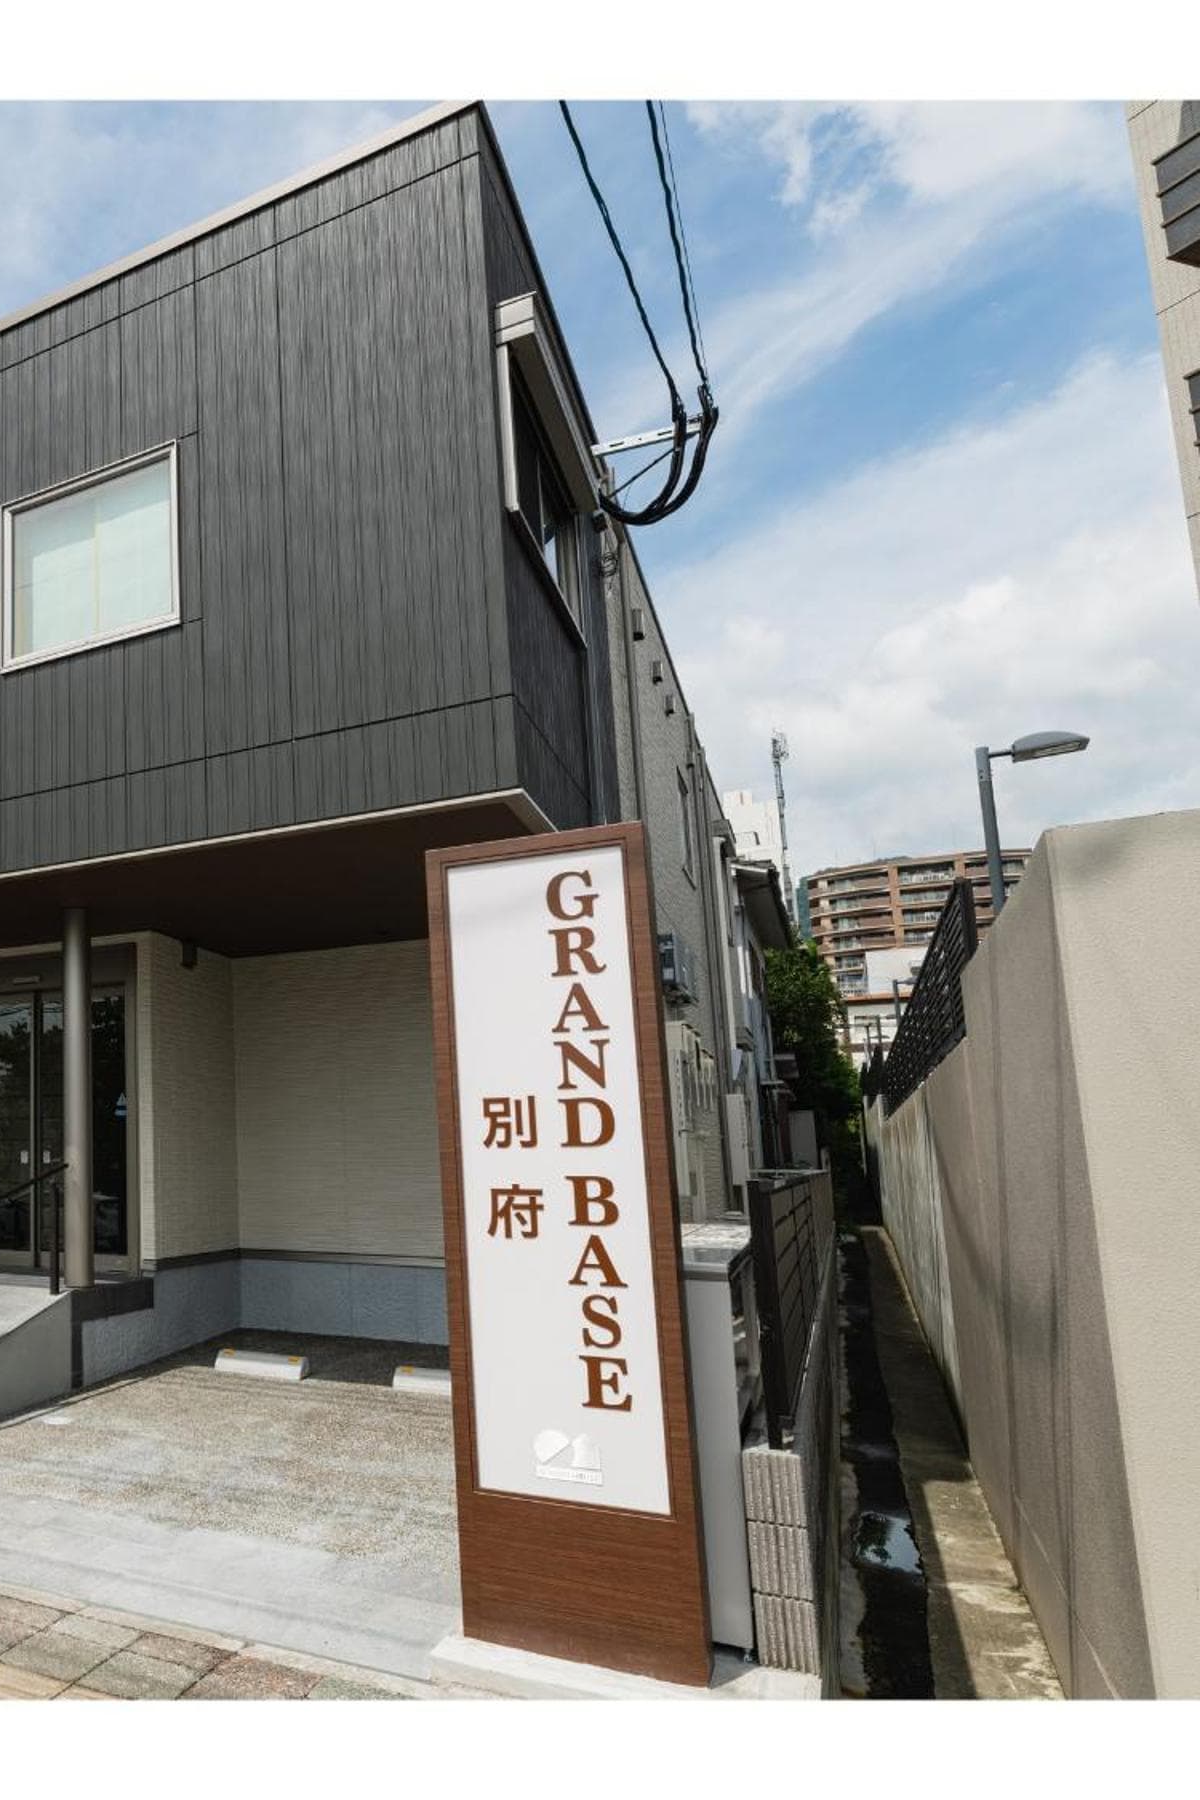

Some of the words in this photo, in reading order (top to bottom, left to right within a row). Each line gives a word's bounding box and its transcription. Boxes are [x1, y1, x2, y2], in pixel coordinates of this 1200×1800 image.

[546, 870, 615, 1147] GRAND
[482, 1095, 545, 1240] 別府
[565, 1175, 633, 1412] BASE
